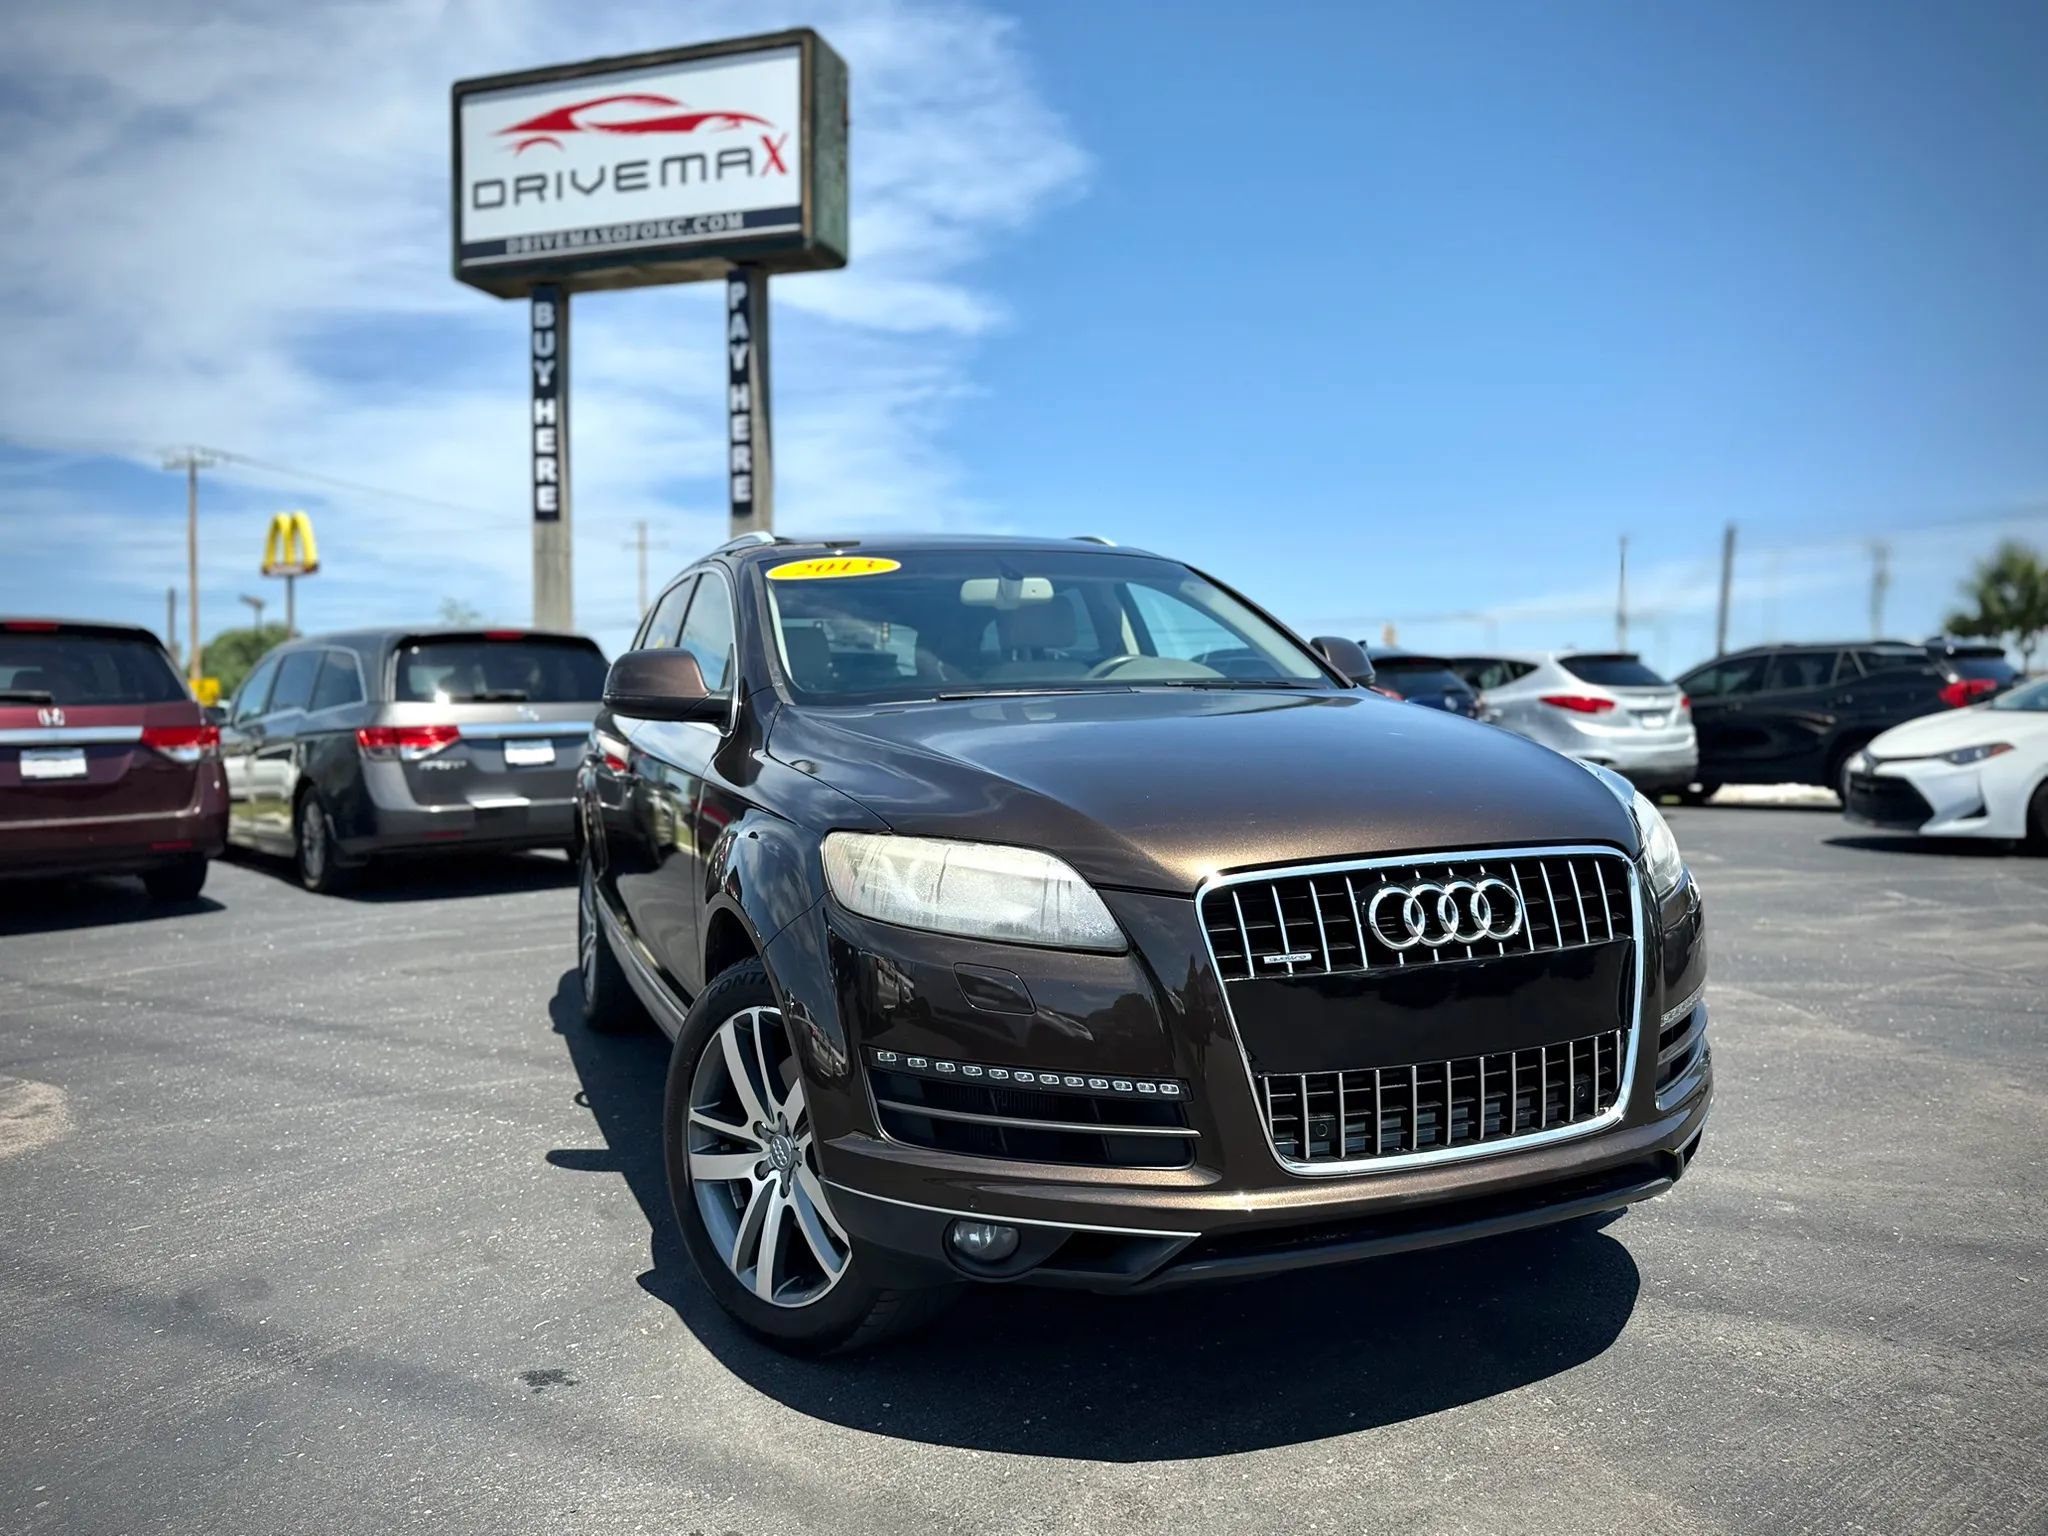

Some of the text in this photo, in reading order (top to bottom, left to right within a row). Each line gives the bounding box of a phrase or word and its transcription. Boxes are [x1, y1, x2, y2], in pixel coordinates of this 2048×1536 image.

[472, 132, 788, 211] DRIVEMAX
[505, 211, 745, 255] DRIVEMAXOFOKC.COM
[533, 302, 557, 512] BUY HERE
[729, 281, 751, 502] PAY HERE
